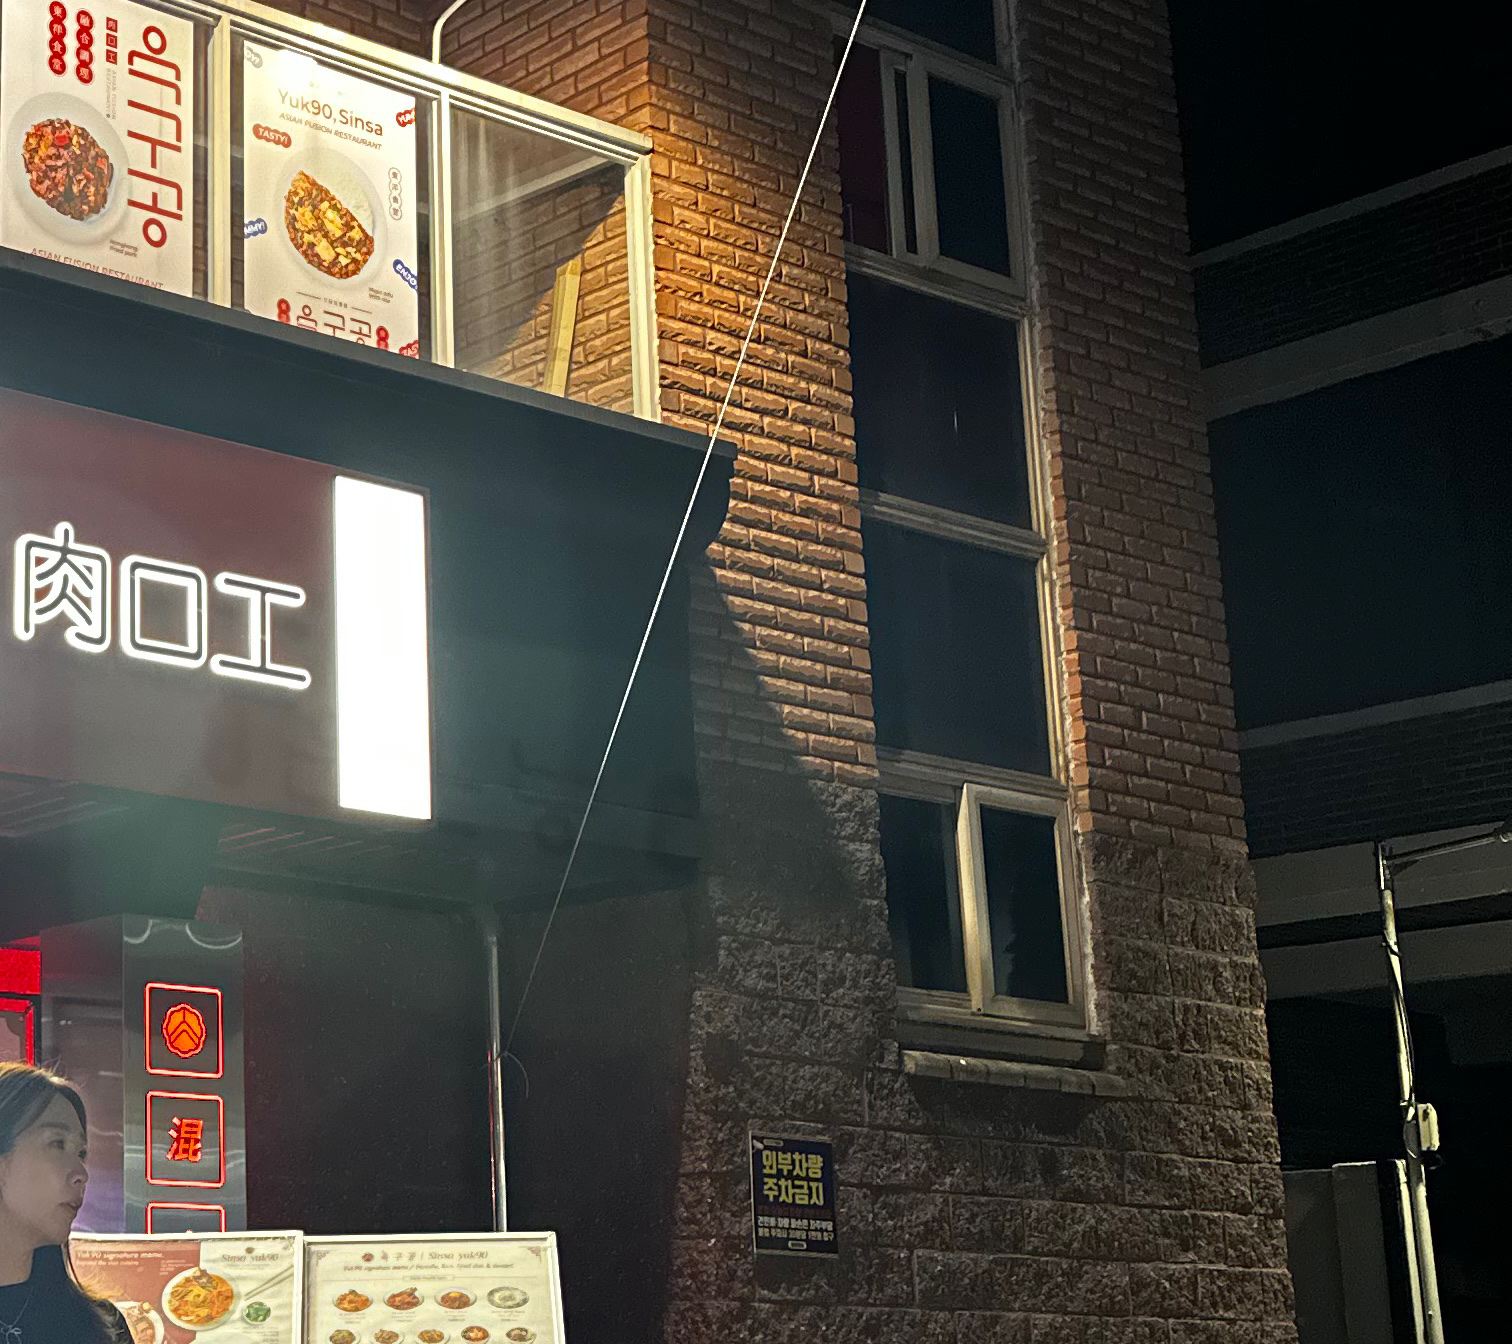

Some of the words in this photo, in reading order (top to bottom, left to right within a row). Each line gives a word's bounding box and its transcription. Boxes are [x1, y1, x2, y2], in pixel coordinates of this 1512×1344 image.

[278, 88, 384, 138] Yuk90,Sinsa
[13, 520, 312, 691] 肉口工
[165, 1116, 204, 1164] 混
[762, 1149, 824, 1179] 외부차량
[762, 1177, 825, 1206] 주차금지
